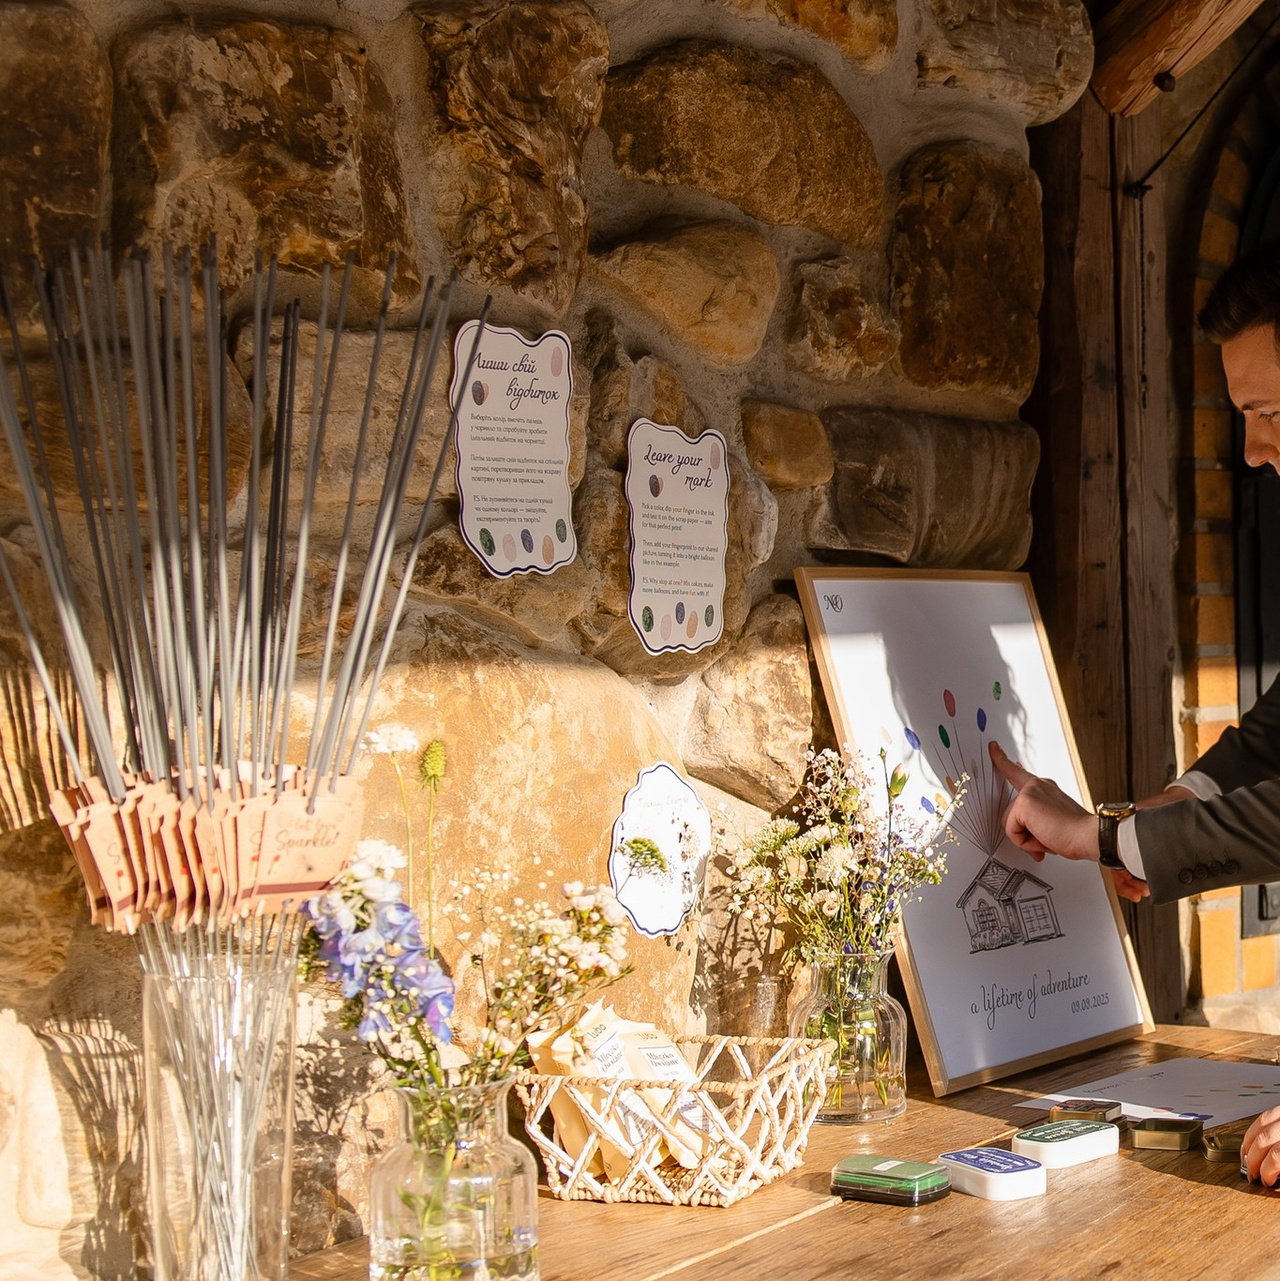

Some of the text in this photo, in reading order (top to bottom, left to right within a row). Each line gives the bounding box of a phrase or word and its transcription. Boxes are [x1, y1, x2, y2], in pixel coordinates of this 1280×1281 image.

[513, 353, 537, 373] свій
[644, 443, 703, 475] Leave your
[684, 467, 713, 491] mark
[970, 969, 1091, 1032] a lifetime of adventure
